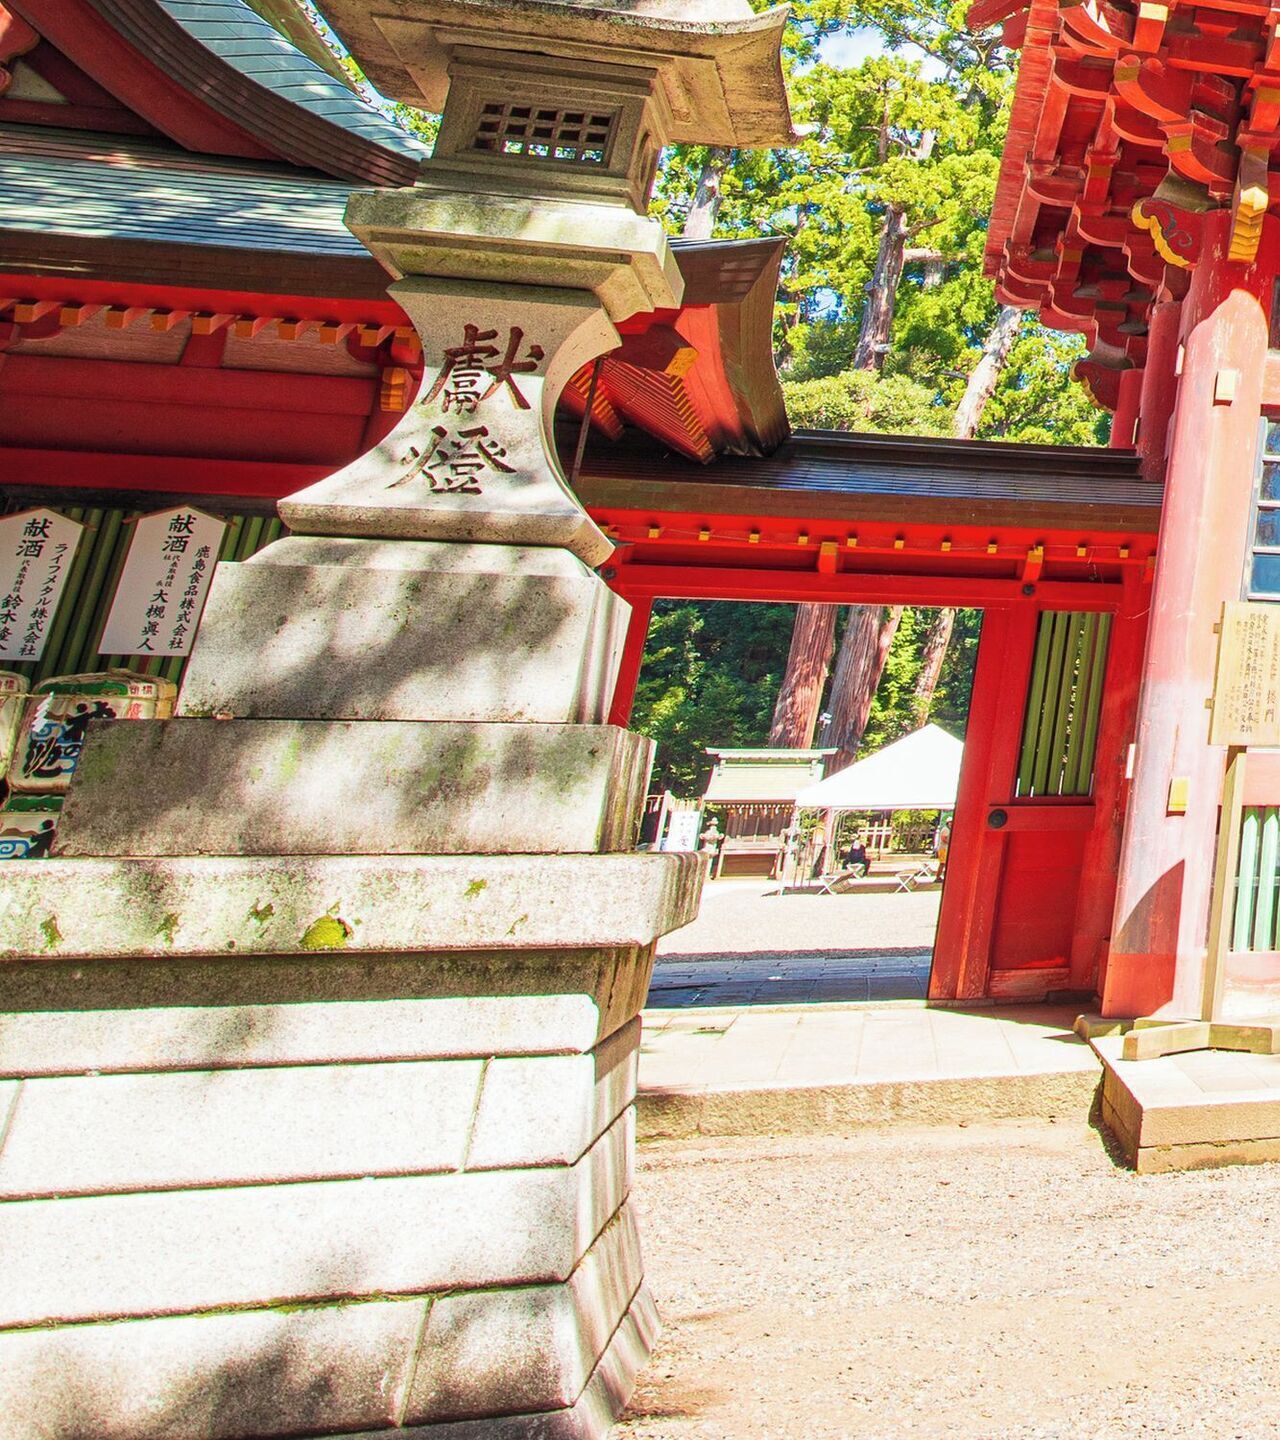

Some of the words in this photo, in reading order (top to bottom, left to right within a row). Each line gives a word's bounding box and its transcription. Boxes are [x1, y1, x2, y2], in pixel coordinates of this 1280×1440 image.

[15, 517, 53, 558] 献酒
[161, 513, 197, 554] 献酒
[19, 542, 68, 656] ライフメタル株式会社
[167, 545, 211, 650] 鹿島食品株式会社
